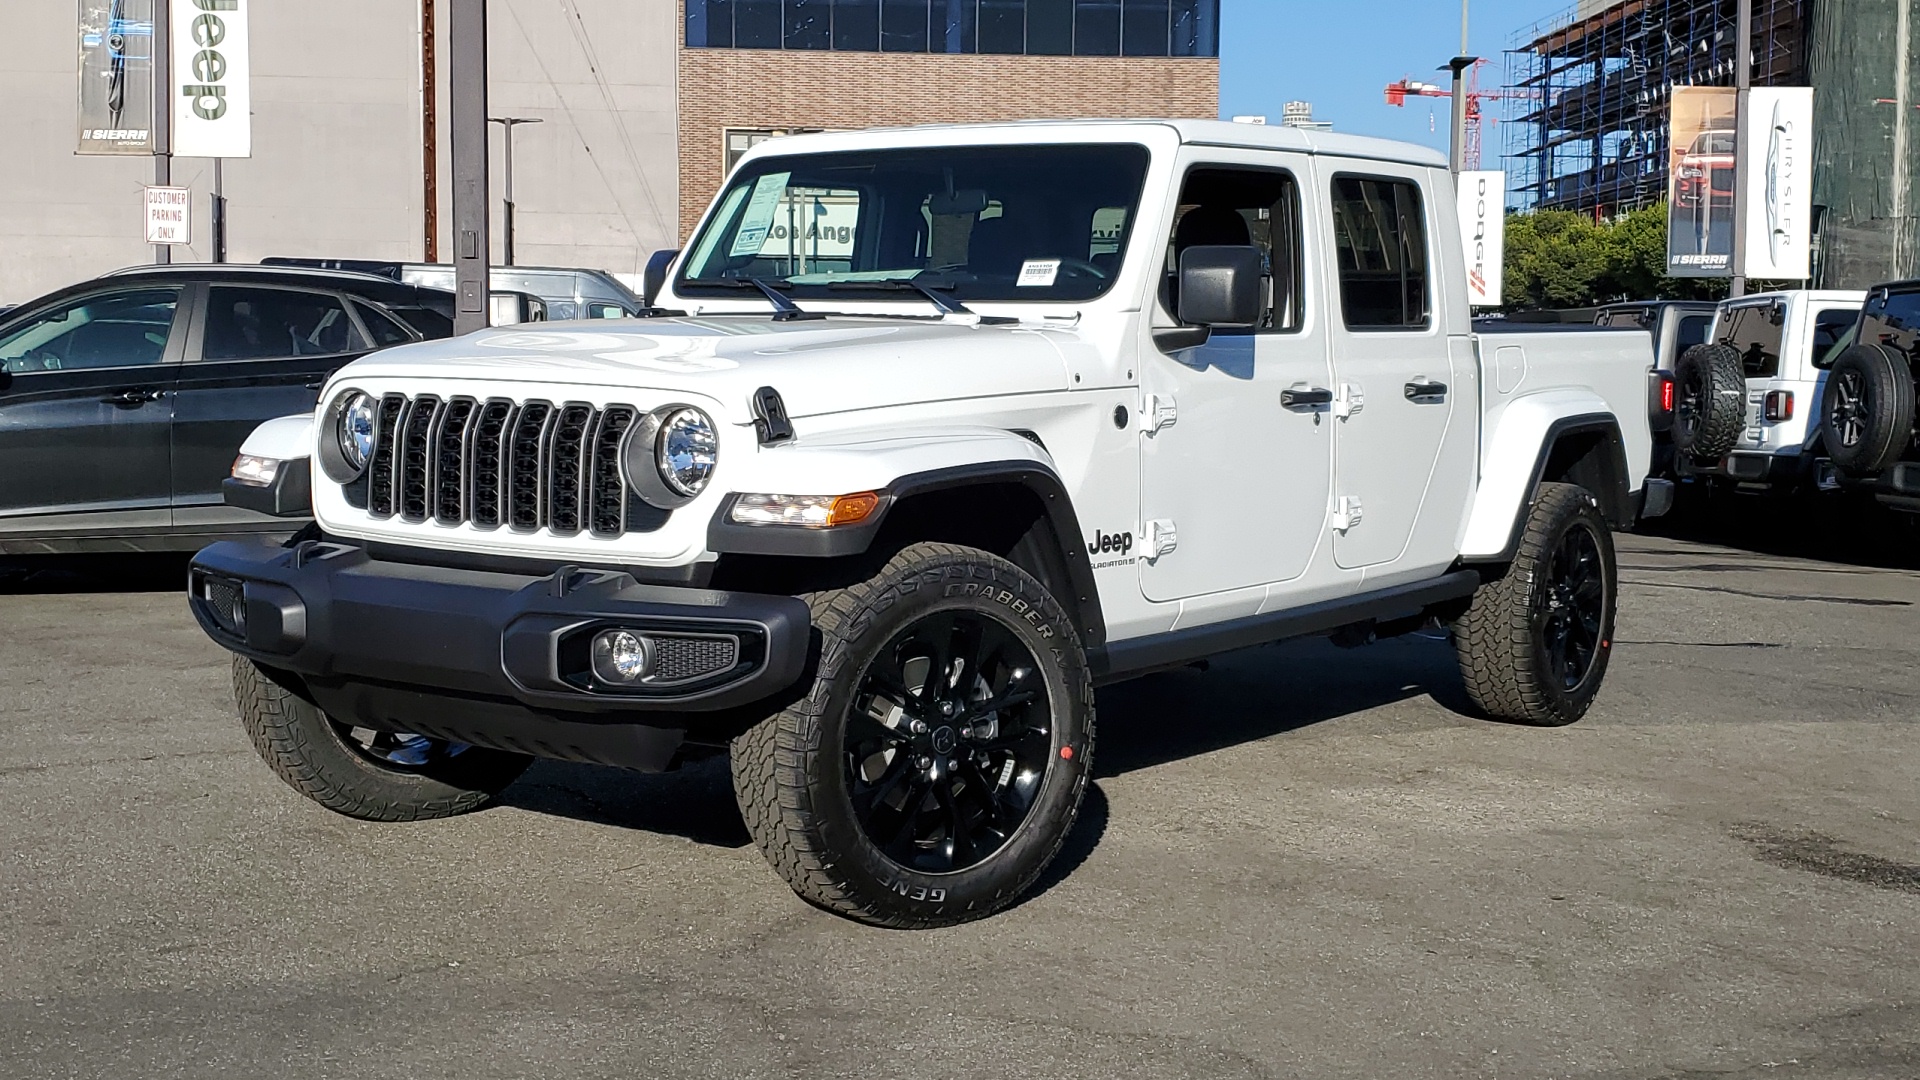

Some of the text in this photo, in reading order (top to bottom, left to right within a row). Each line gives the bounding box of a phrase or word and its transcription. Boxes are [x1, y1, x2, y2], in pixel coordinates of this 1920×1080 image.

[92, 129, 149, 140] SIERRA
[1782, 120, 1793, 246] CHRYSLER
[149, 191, 186, 205] CUSTOMER
[152, 209, 182, 222] PARKING
[158, 226, 175, 239] ONLY
[1473, 178, 1486, 281] DODGE
[1680, 254, 1729, 264] SIERRA
[1088, 529, 1133, 556] Jeep
